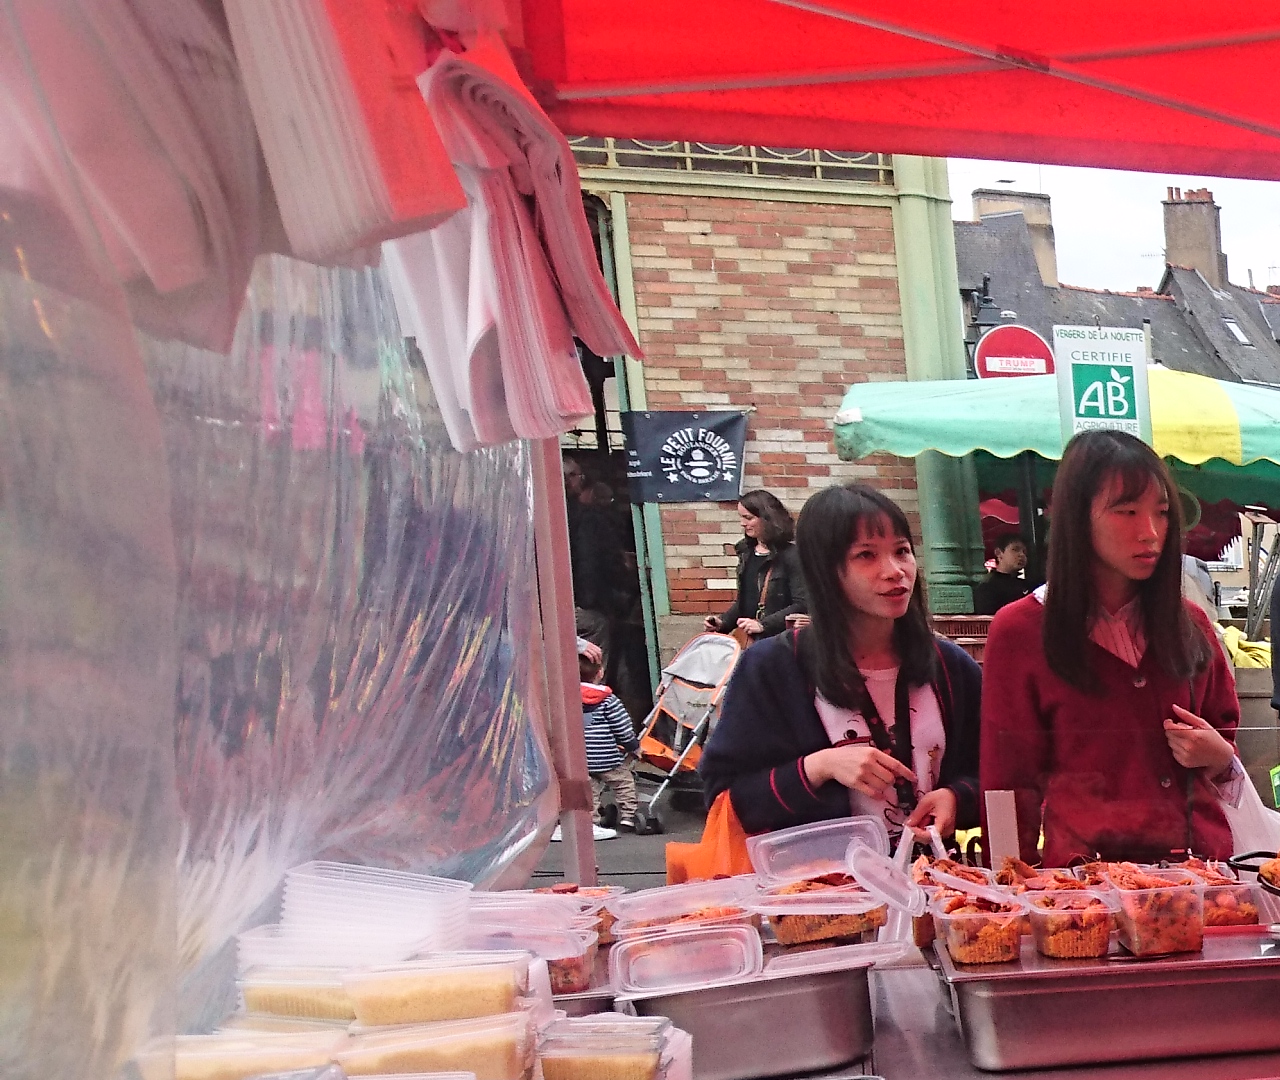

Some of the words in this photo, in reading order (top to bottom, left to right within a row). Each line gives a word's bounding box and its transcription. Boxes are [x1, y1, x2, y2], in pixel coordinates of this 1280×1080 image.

[1055, 328, 1086, 340] VERGERS
[1088, 330, 1098, 340] DE
[1099, 331, 1109, 340] LA
[1110, 332, 1144, 343] NOUETTE
[998, 359, 1035, 367] TRUMP
[1070, 350, 1132, 363] CERTIFIE
[1078, 380, 1129, 416] AB
[662, 427, 695, 456] PETIT
[697, 428, 738, 471] FOURNIL
[660, 456, 678, 472] LE
